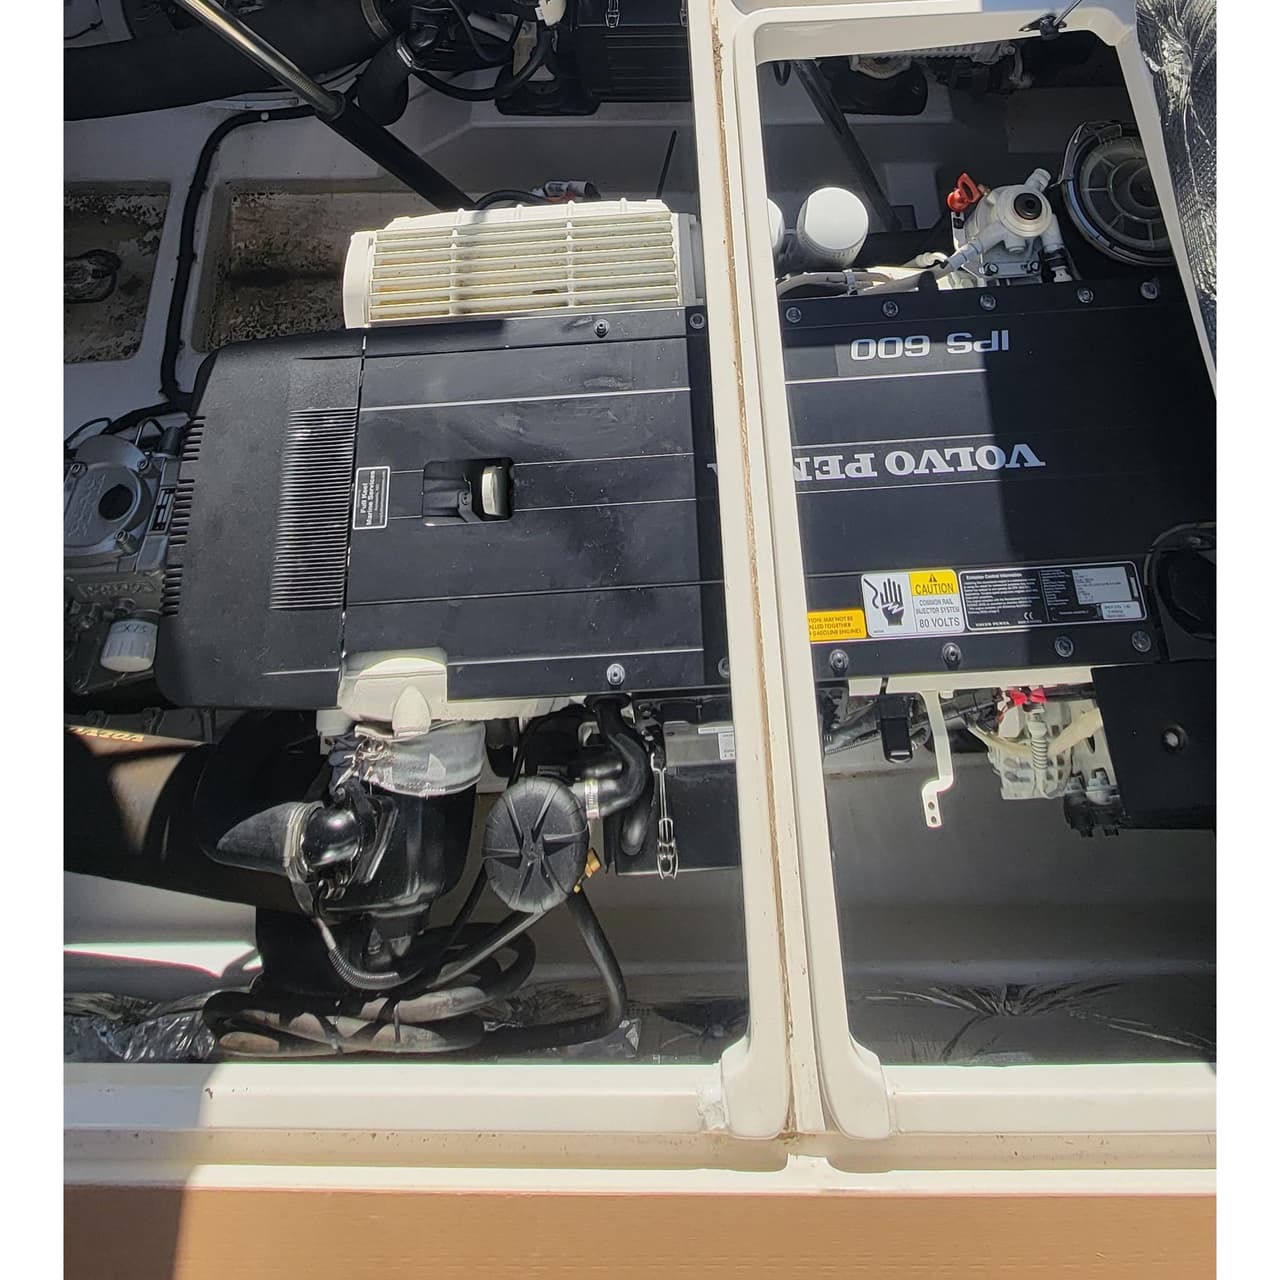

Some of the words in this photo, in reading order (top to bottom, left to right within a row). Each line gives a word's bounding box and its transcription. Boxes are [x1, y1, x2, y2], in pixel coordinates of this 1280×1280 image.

[850, 335, 931, 361] 600
[946, 329, 1010, 354] IPS
[884, 443, 1046, 476] VOLVO
[368, 470, 376, 500] Services
[915, 583, 954, 595] CAUTION
[915, 607, 940, 615] INJECTOR
[940, 606, 960, 614] SYSTEM
[919, 599, 941, 607] COMMON
[919, 618, 930, 629] 80
[931, 616, 960, 628] VOLTS
